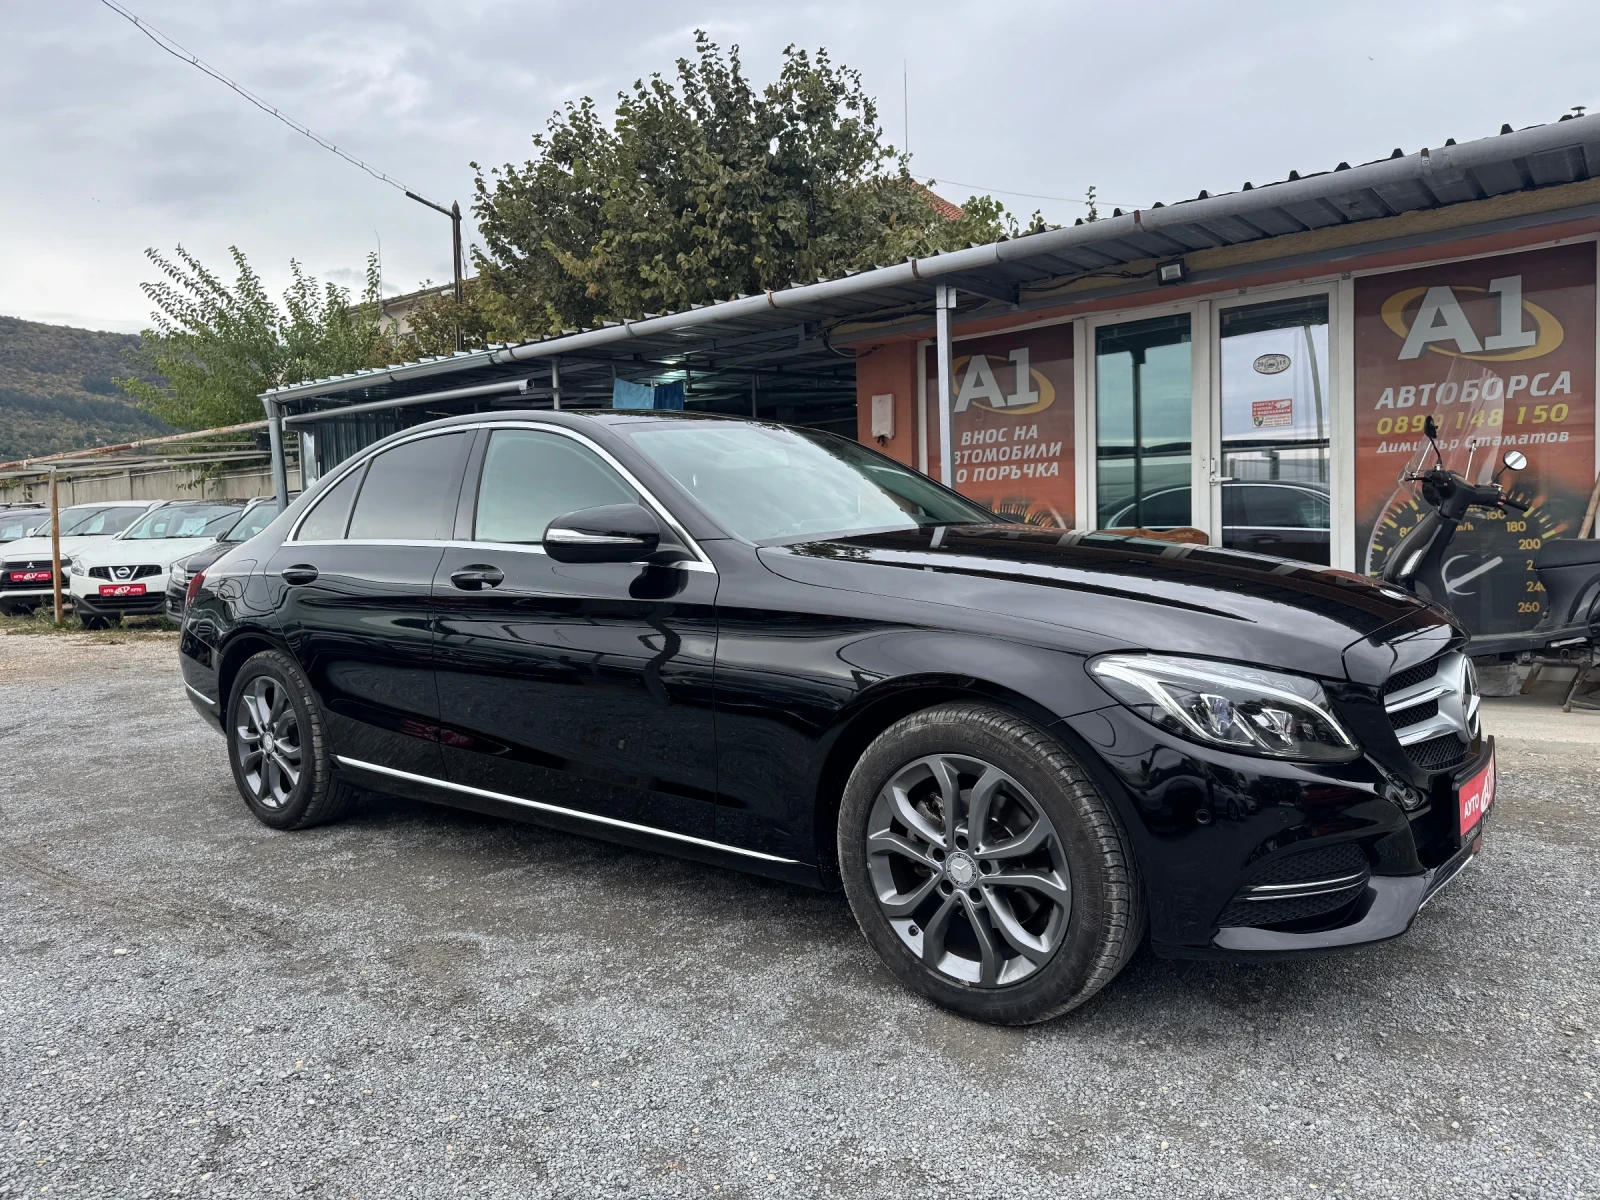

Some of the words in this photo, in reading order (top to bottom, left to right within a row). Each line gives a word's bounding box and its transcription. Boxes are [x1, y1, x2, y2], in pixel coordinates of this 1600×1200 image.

[1398, 275, 1536, 360] A1
[953, 347, 1039, 413] A1
[1374, 370, 1571, 410] АВТОБОРСА
[1455, 408, 1503, 430] 148
[1516, 403, 1569, 425] 150
[961, 427, 1008, 446] ВНОС
[1013, 424, 1038, 441] НА
[1376, 438, 1459, 454] Димиър
[1464, 431, 1569, 448] Стаматов
[946, 441, 1062, 465] ВТОМОБИЛИ
[973, 461, 1059, 483] ПОРЪЧКА
[1455, 521, 1474, 531] m/h
[1506, 520, 1527, 533] 180
[1518, 538, 1541, 550] 200
[1526, 581, 1546, 592] 24
[1517, 601, 1540, 613] 260
